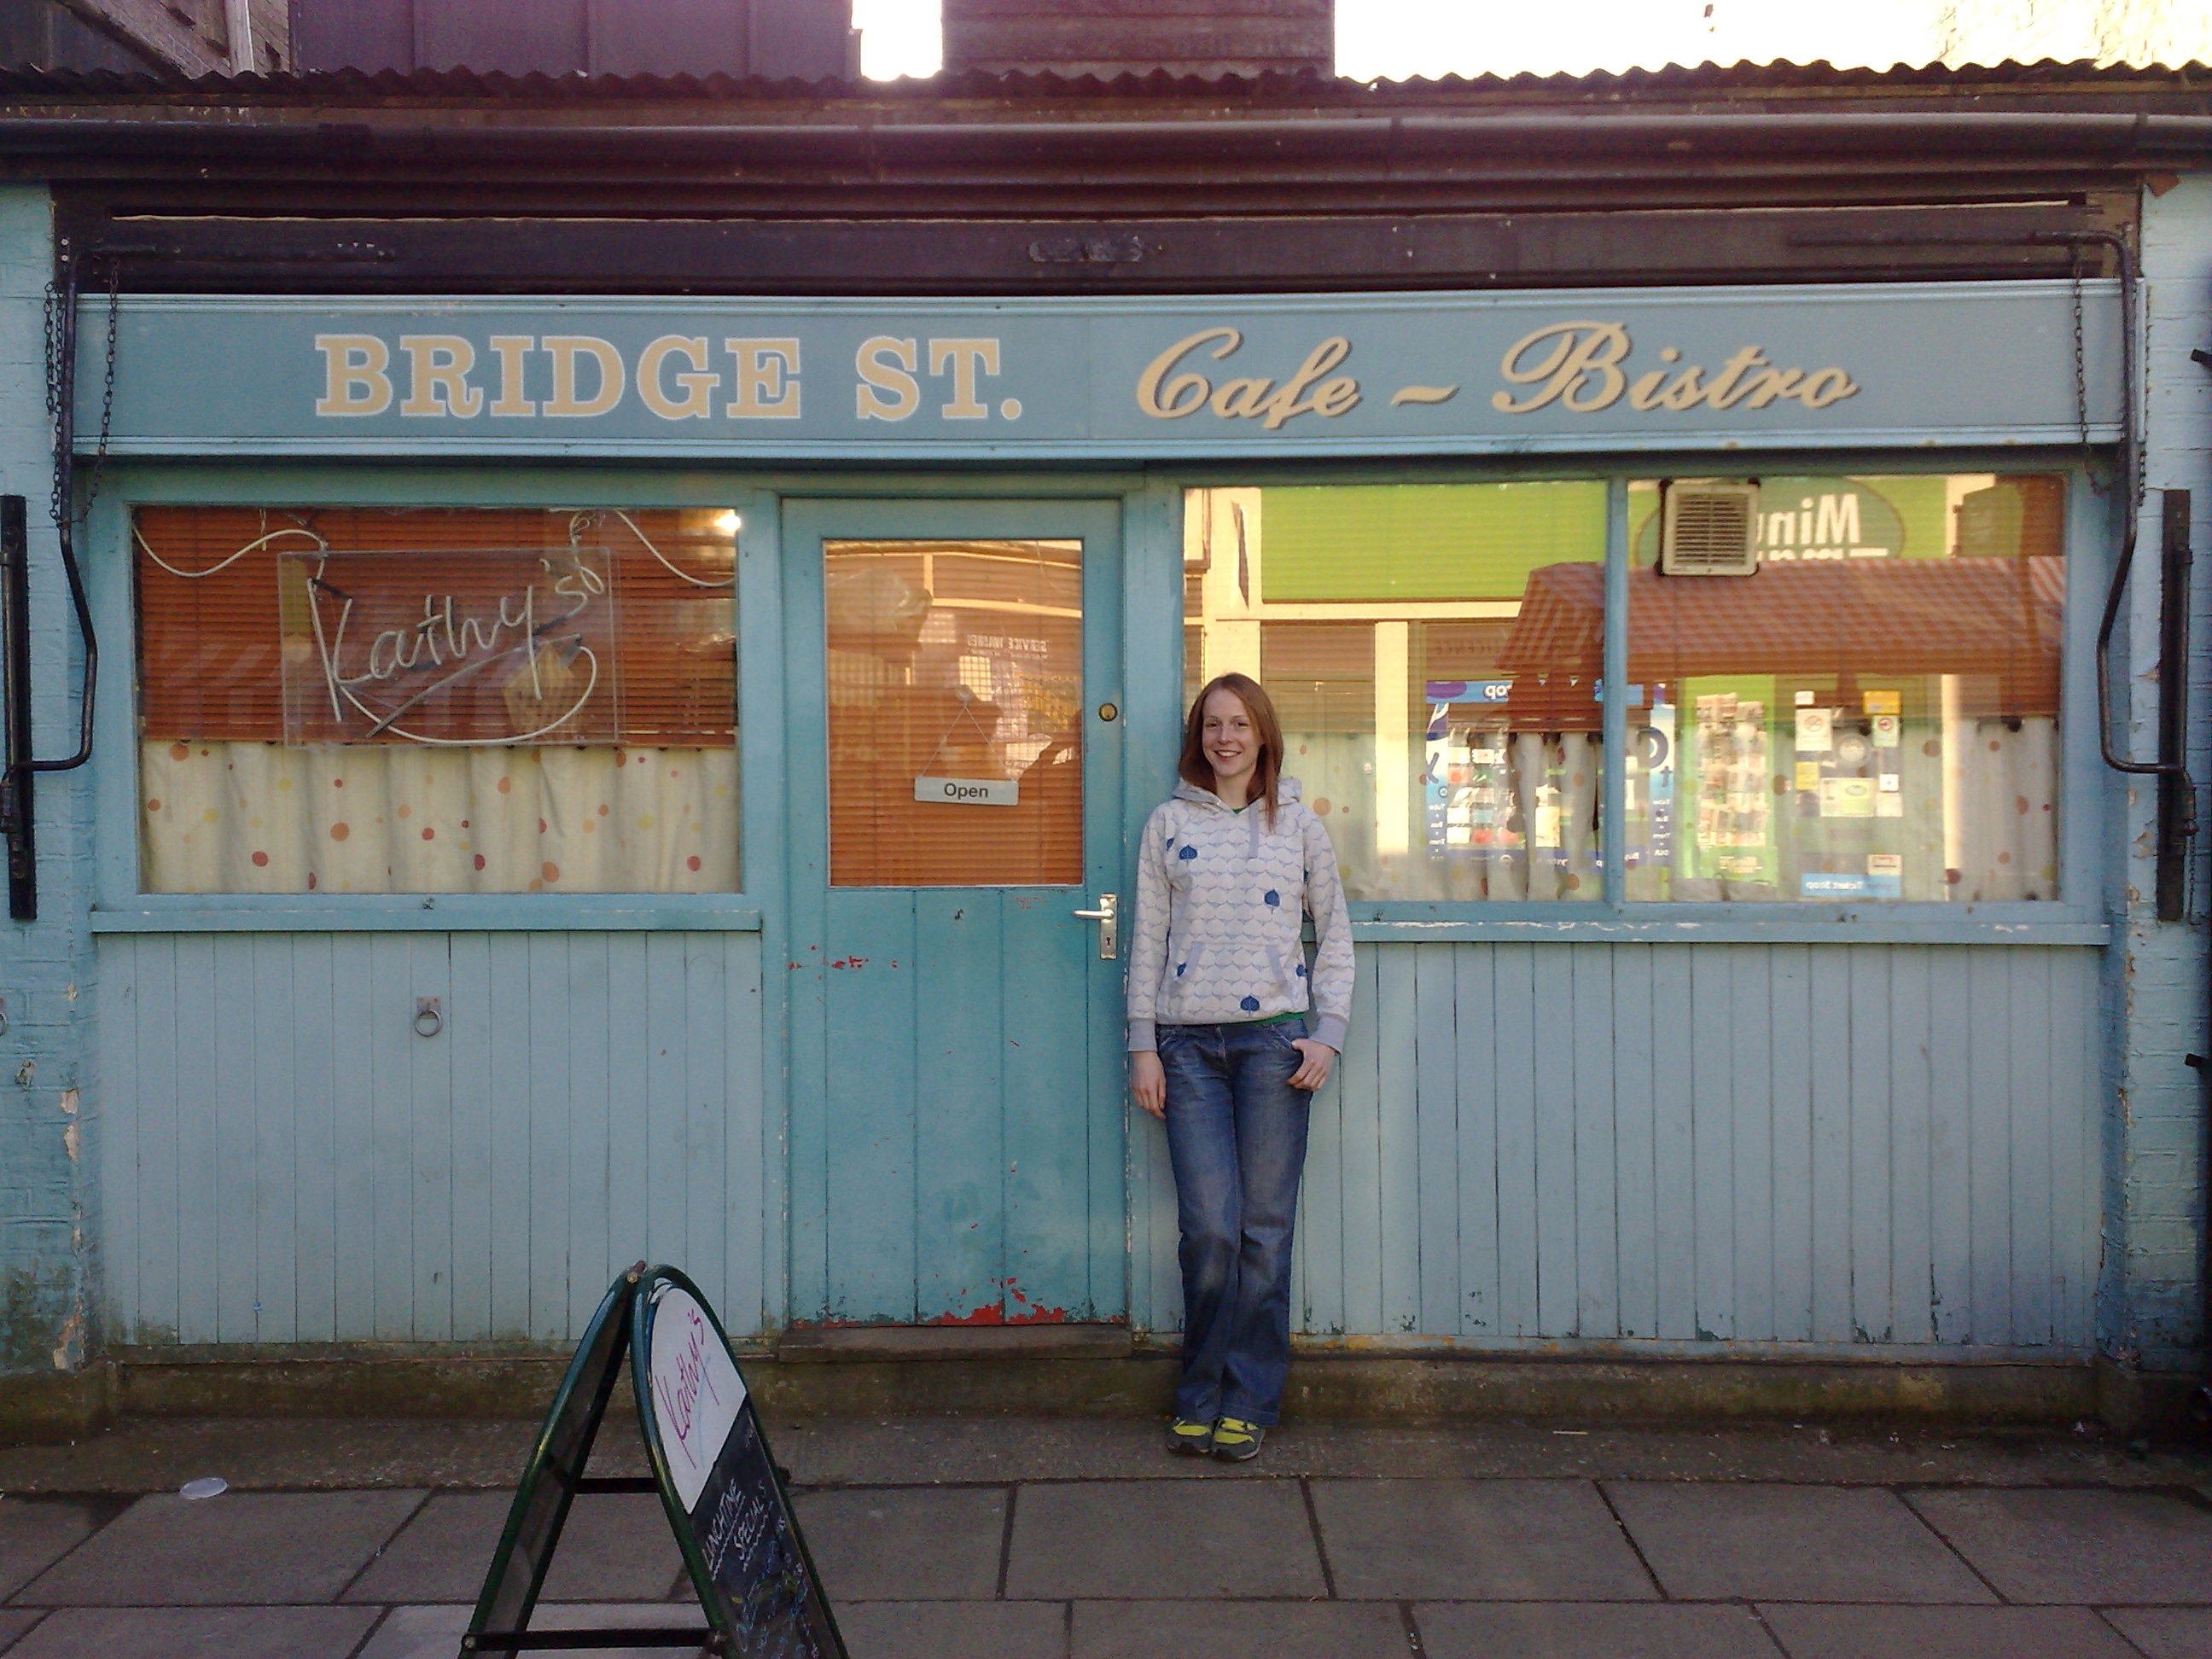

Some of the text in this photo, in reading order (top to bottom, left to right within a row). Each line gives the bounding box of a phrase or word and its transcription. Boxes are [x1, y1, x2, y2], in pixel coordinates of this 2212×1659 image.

[314, 334, 802, 421] BRIDGE
[855, 334, 1023, 422] ST.
[1135, 326, 1364, 432] Cafe
[1491, 318, 1862, 416] Bistro
[306, 558, 591, 723] Kathy's
[944, 783, 989, 800] Open
[655, 1307, 720, 1470] Kathy's
